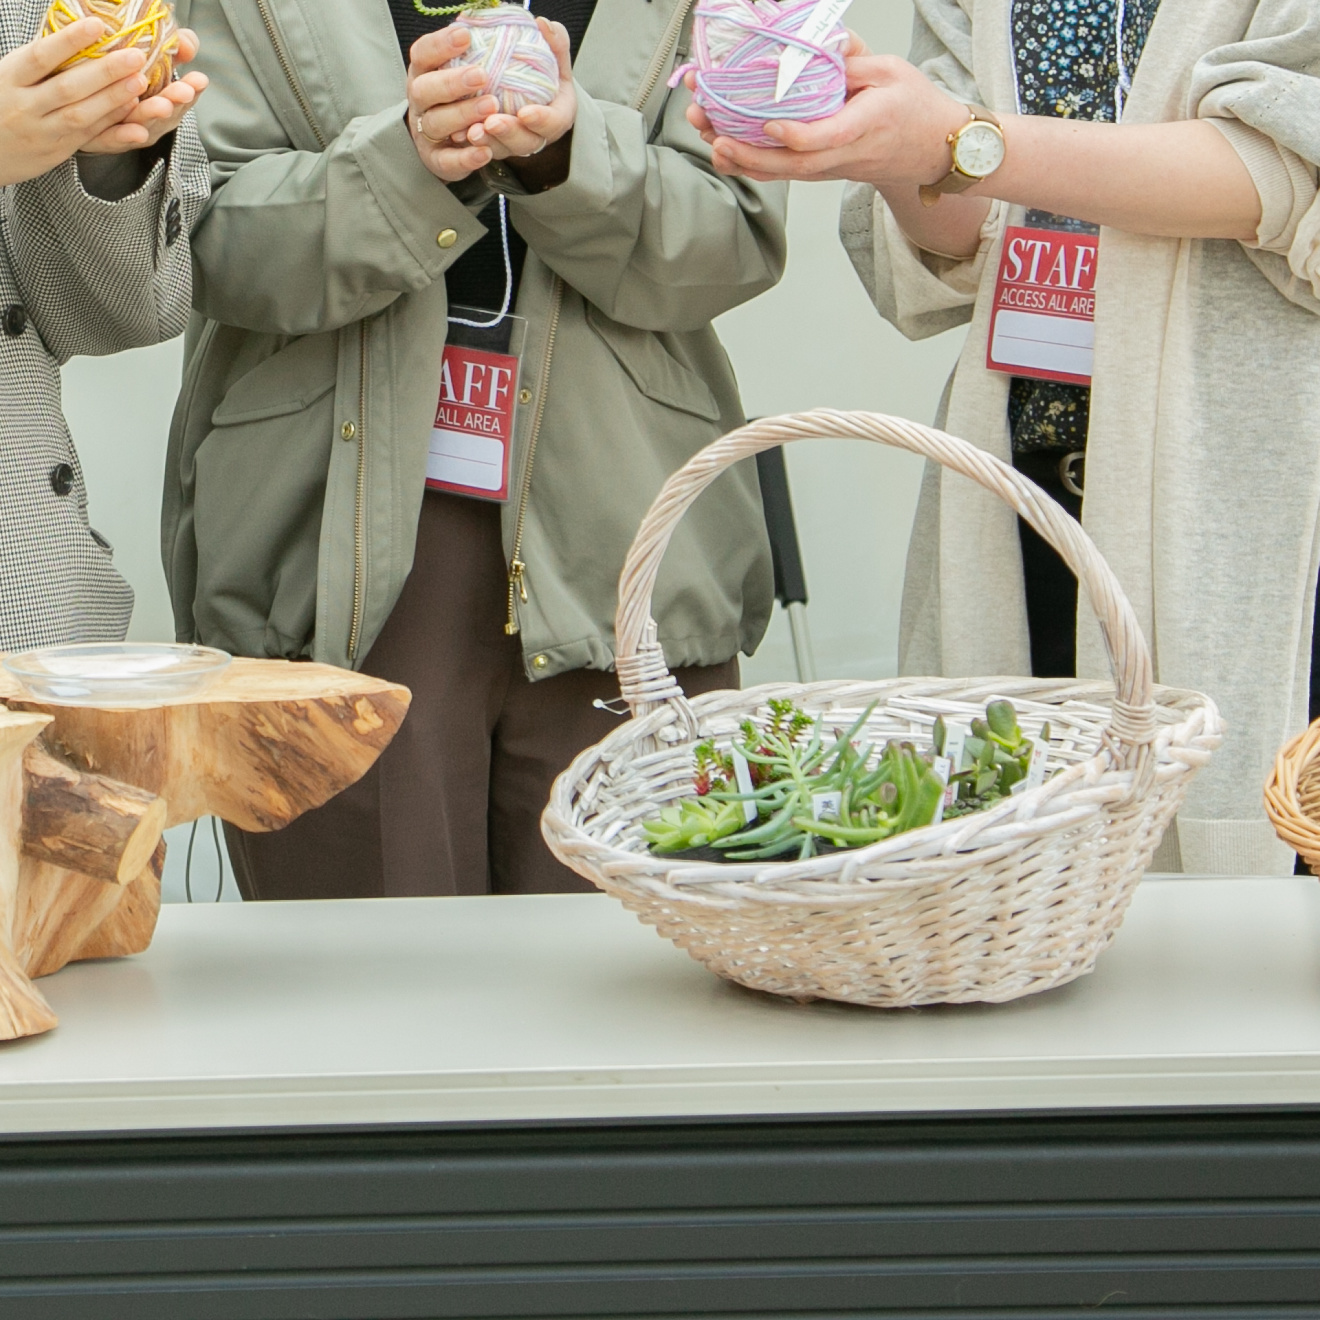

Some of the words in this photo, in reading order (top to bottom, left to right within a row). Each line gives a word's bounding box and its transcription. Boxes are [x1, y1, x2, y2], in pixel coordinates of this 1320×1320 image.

[1002, 237, 1098, 291] STAF
[999, 288, 1046, 309] ACCESS
[1047, 294, 1067, 312] ALL
[1070, 297, 1095, 315] ARE
[439, 358, 512, 411] AFF
[435, 409, 461, 427] ALL
[464, 412, 501, 434] AREA
